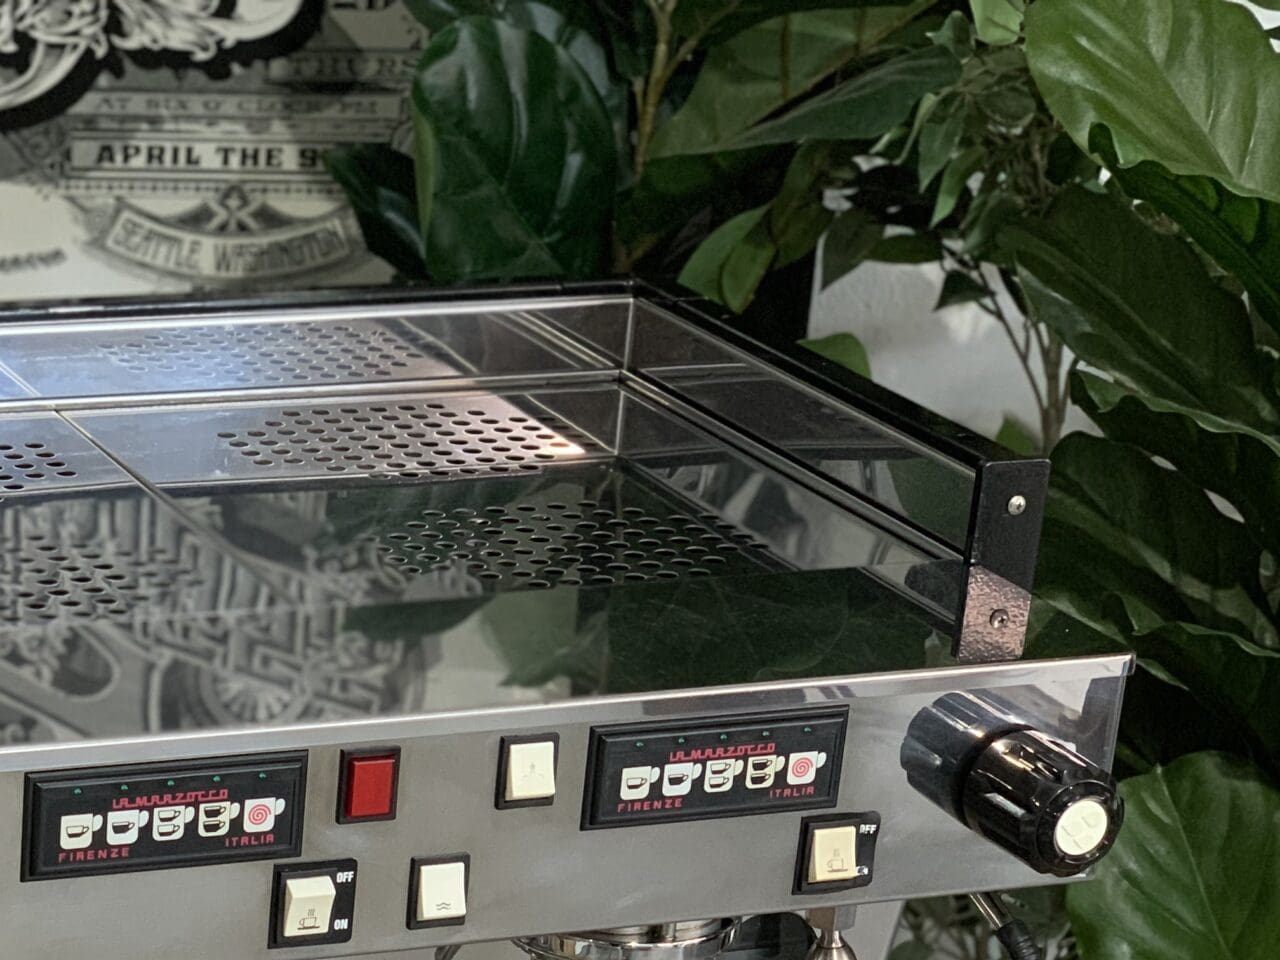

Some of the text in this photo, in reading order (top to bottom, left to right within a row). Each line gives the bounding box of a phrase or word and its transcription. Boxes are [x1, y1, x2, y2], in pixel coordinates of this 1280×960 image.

[145, 97, 188, 113] SIX
[96, 144, 200, 167] APRIL
[214, 145, 284, 167] THE
[617, 786, 815, 813] FIRENZE ITALIA
[58, 833, 275, 864] FIRENZE ITALIA
[336, 871, 354, 883] OFF
[333, 918, 349, 931] ON
